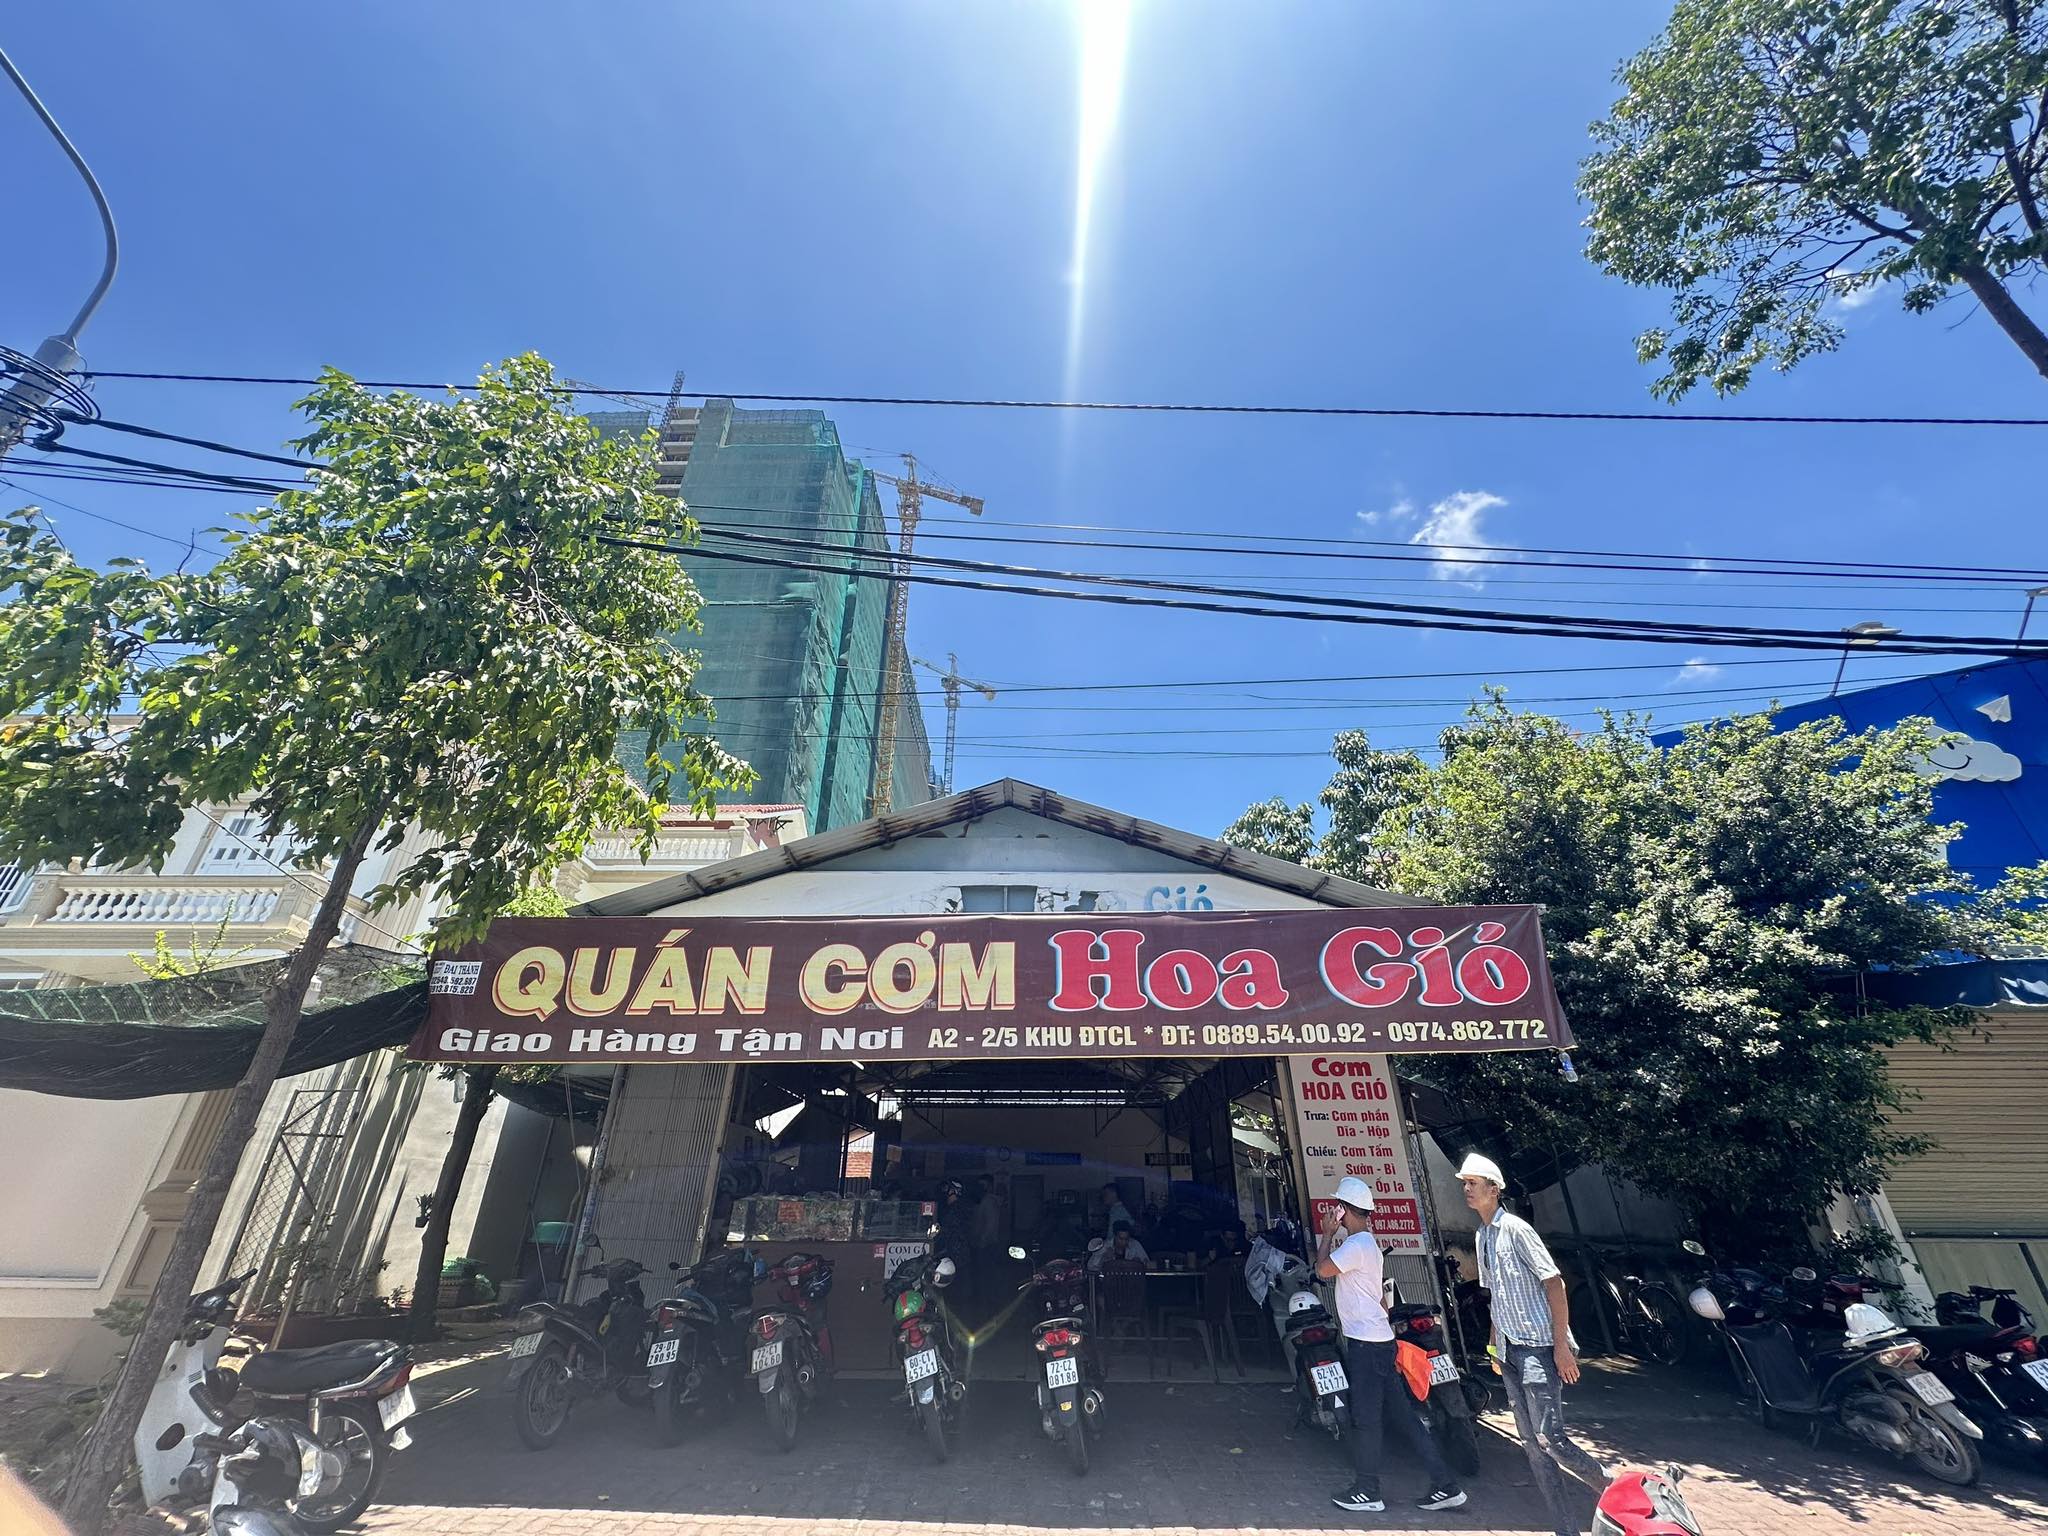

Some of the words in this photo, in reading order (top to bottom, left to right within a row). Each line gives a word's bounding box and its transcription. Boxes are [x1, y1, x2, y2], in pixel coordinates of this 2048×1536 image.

[492, 928, 773, 1022] QUÁN
[798, 930, 1016, 1015] CƠM
[1048, 929, 1289, 1011] Hoa
[1319, 921, 1531, 1007] Gió
[439, 1028, 552, 1053] Giao
[568, 1027, 698, 1056] Hàng
[715, 1027, 803, 1058] Tận
[820, 1026, 904, 1051] Nơi
[928, 1027, 959, 1049] A2
[981, 1026, 1018, 1048] 2/5
[1025, 1026, 1073, 1047] KHU
[1079, 1025, 1138, 1047] ĐTCL
[1160, 1024, 1197, 1046] ĐT:
[1202, 1021, 1366, 1046] 0889.54.00.92
[1387, 1019, 1548, 1044] 0974.862.772
[1311, 1057, 1372, 1077] Cơm
[1302, 1081, 1346, 1100] HOA
[1351, 1077, 1388, 1100] GIÓ
[1304, 1110, 1329, 1121] Trưa:
[1332, 1110, 1358, 1121] Cơm
[1367, 1126, 1390, 1139] Hộp
[1341, 1146, 1366, 1157] Cơm
[1368, 1144, 1393, 1157] Tấm
[1384, 1163, 1396, 1175] Bì
[1376, 1177, 1391, 1193] Ốp
[1393, 1181, 1405, 1192] la
[1394, 1202, 1411, 1213] nơi
[1051, 1359, 1072, 1374] 72-C2
[1429, 1356, 1449, 1370] 2-C1
[1316, 1365, 1339, 1380] 62-H1
